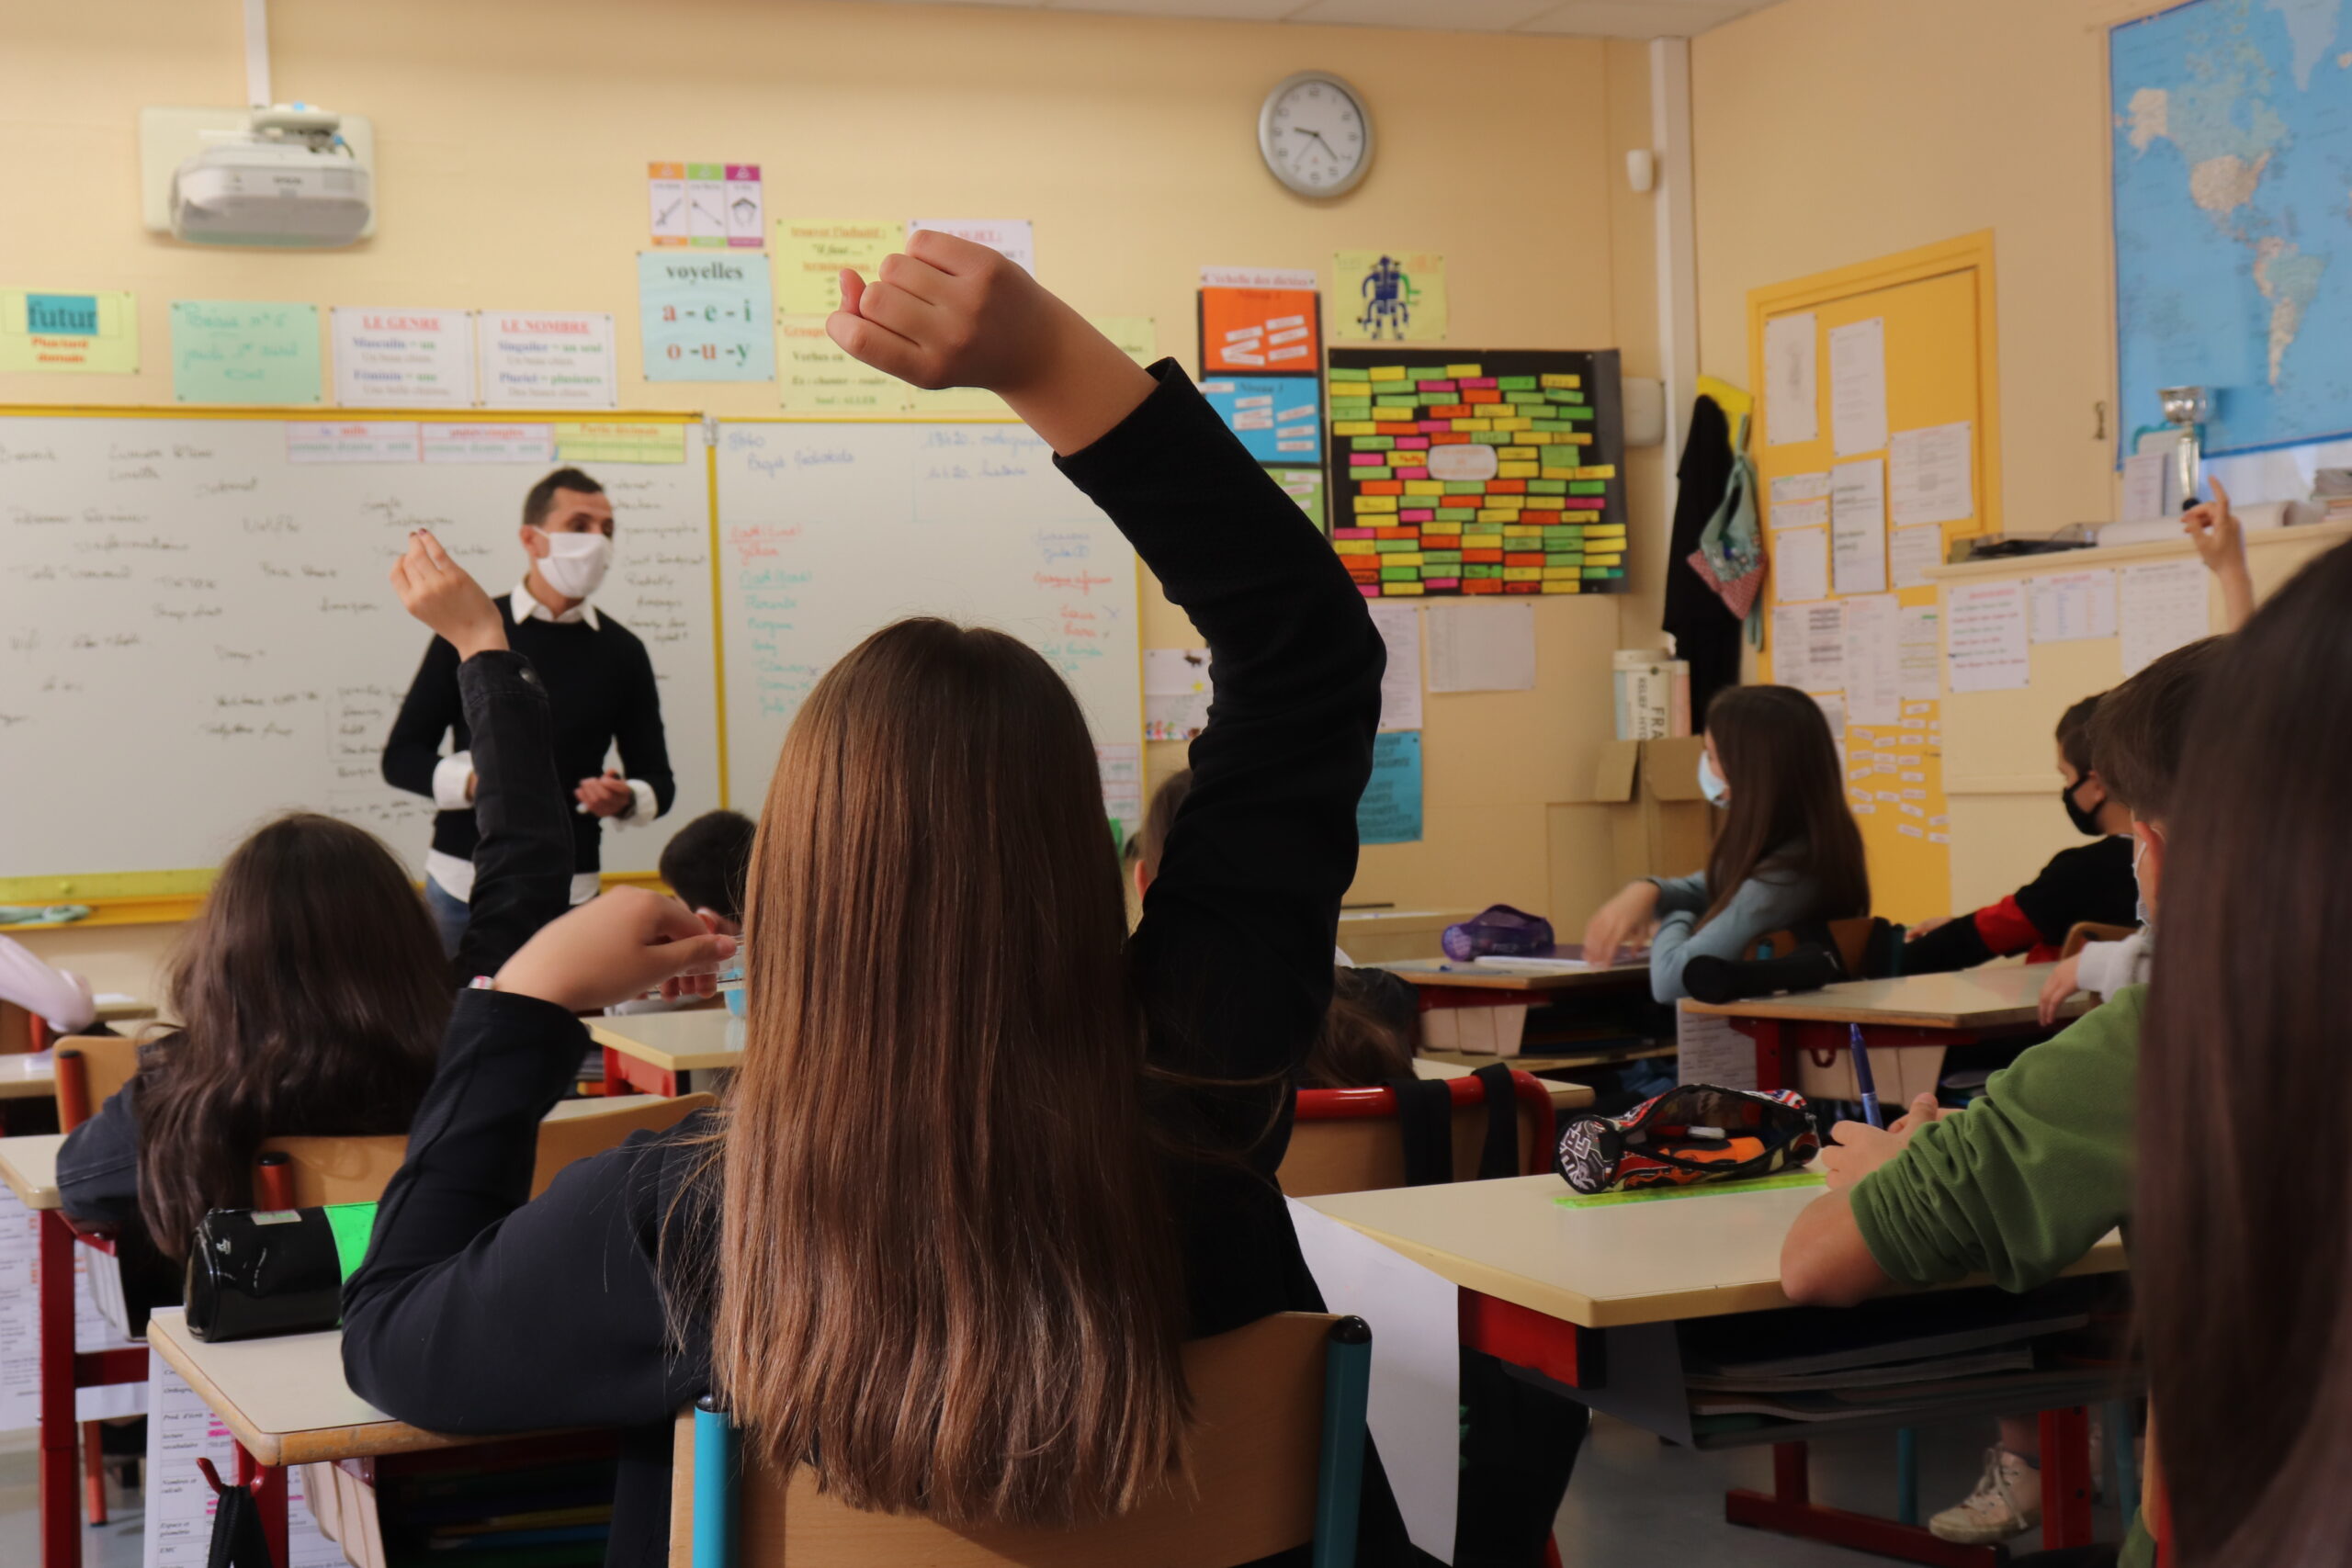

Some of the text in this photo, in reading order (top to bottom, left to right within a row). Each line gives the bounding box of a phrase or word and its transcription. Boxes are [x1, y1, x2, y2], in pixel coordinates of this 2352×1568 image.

[666, 262, 743, 285] voyelles
[28, 300, 97, 329] futur
[662, 305, 676, 322] a
[704, 304, 718, 323] e
[744, 299, 752, 322] i
[363, 315, 440, 332] LE GENRE
[501, 319, 590, 334] LE NOMBRE
[667, 343, 682, 361] o
